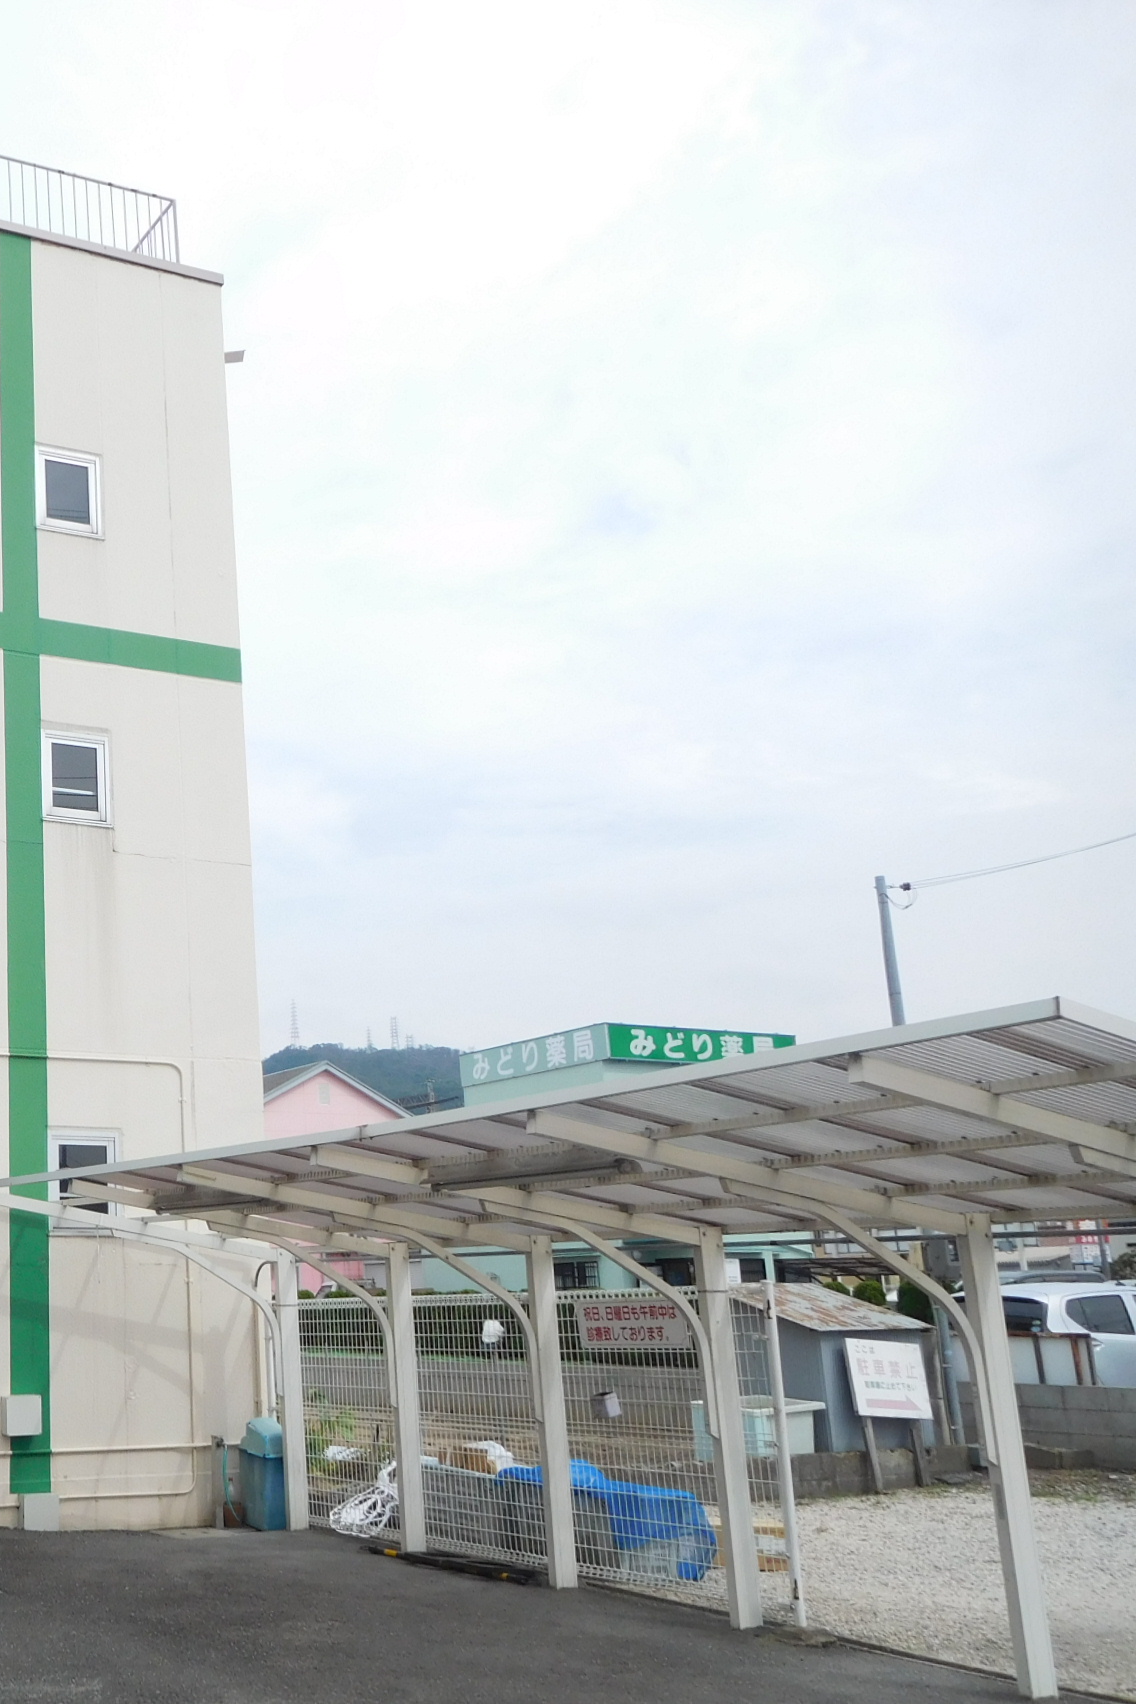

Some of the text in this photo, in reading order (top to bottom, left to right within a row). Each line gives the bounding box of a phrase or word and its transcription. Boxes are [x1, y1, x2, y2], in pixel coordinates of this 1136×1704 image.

[472, 1029, 594, 1080] みどり薬局
